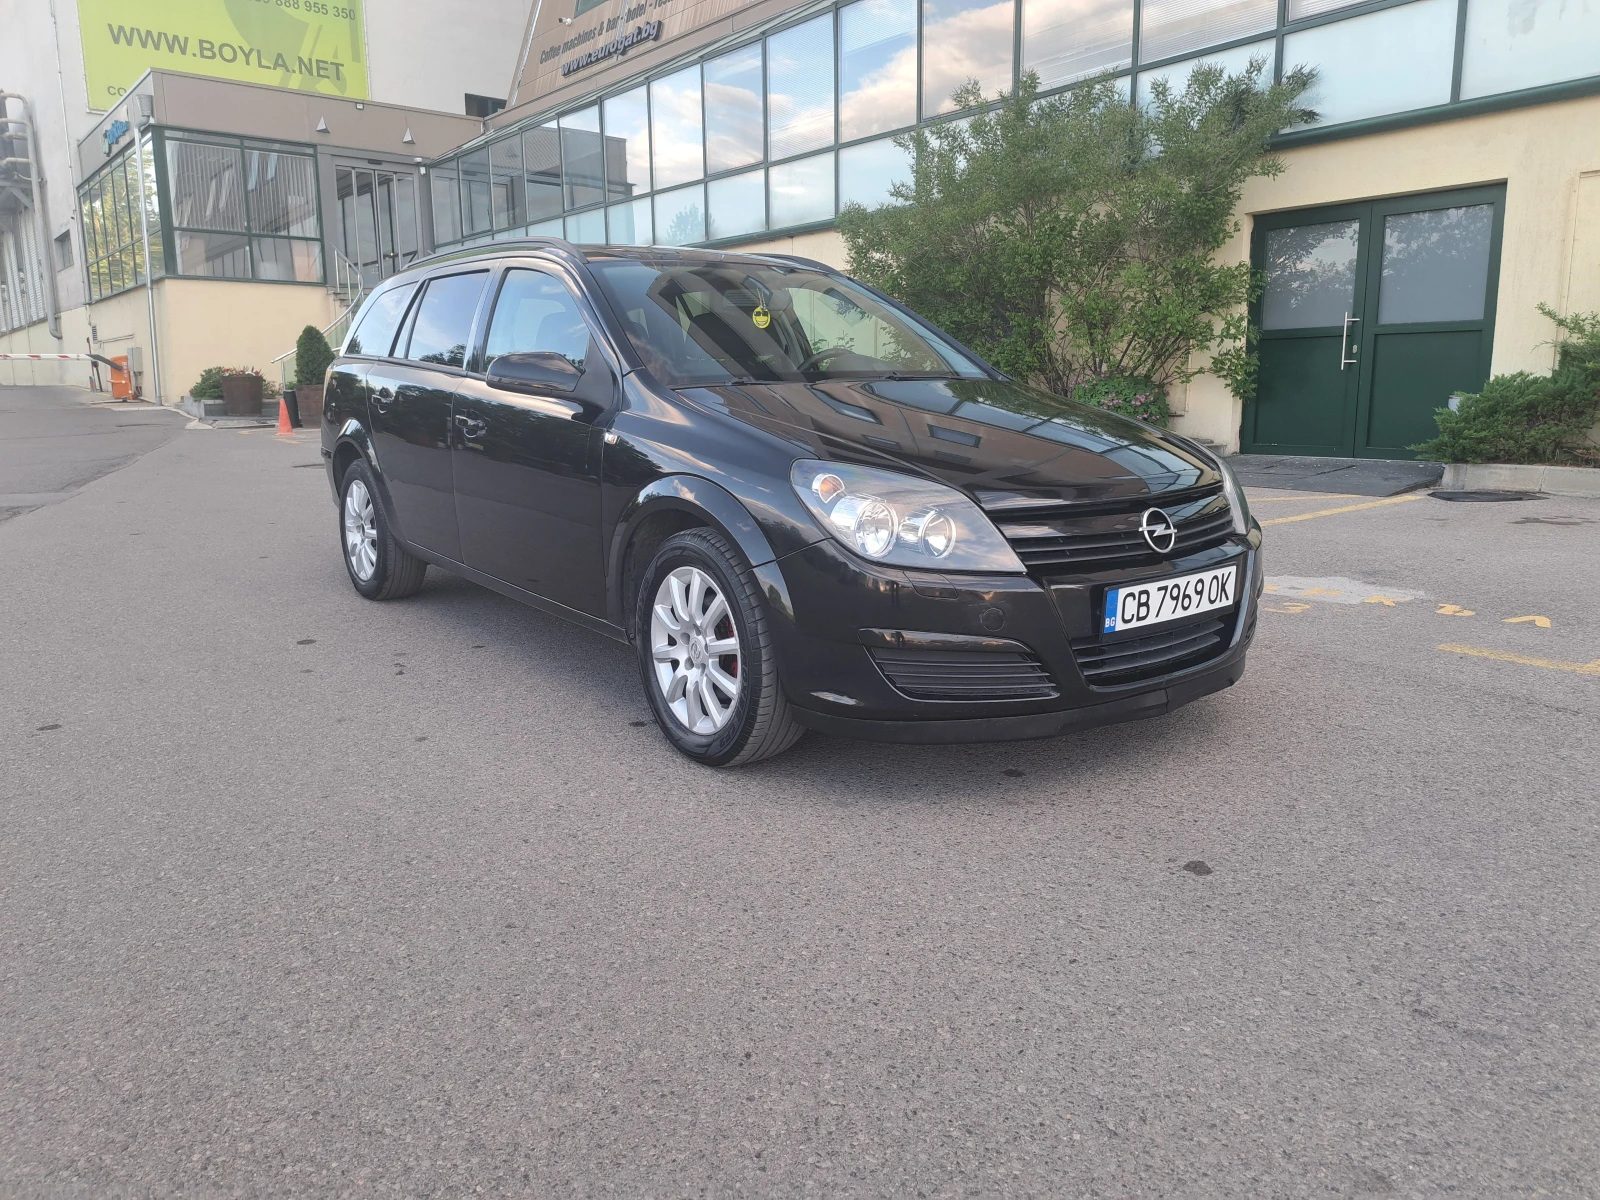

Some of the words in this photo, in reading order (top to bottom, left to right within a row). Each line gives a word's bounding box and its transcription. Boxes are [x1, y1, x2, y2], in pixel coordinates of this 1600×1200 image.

[304, 0, 329, 15] 955
[332, 6, 356, 20] 350
[561, 27, 597, 54] machines
[625, 0, 648, 23] hotel
[106, 23, 345, 82] WWW.BOYLA.NET
[561, 21, 659, 75] www.eurogat.bg
[1105, 617, 1115, 627] BG
[1121, 589, 1150, 624] CB
[1155, 578, 1204, 618] 7969
